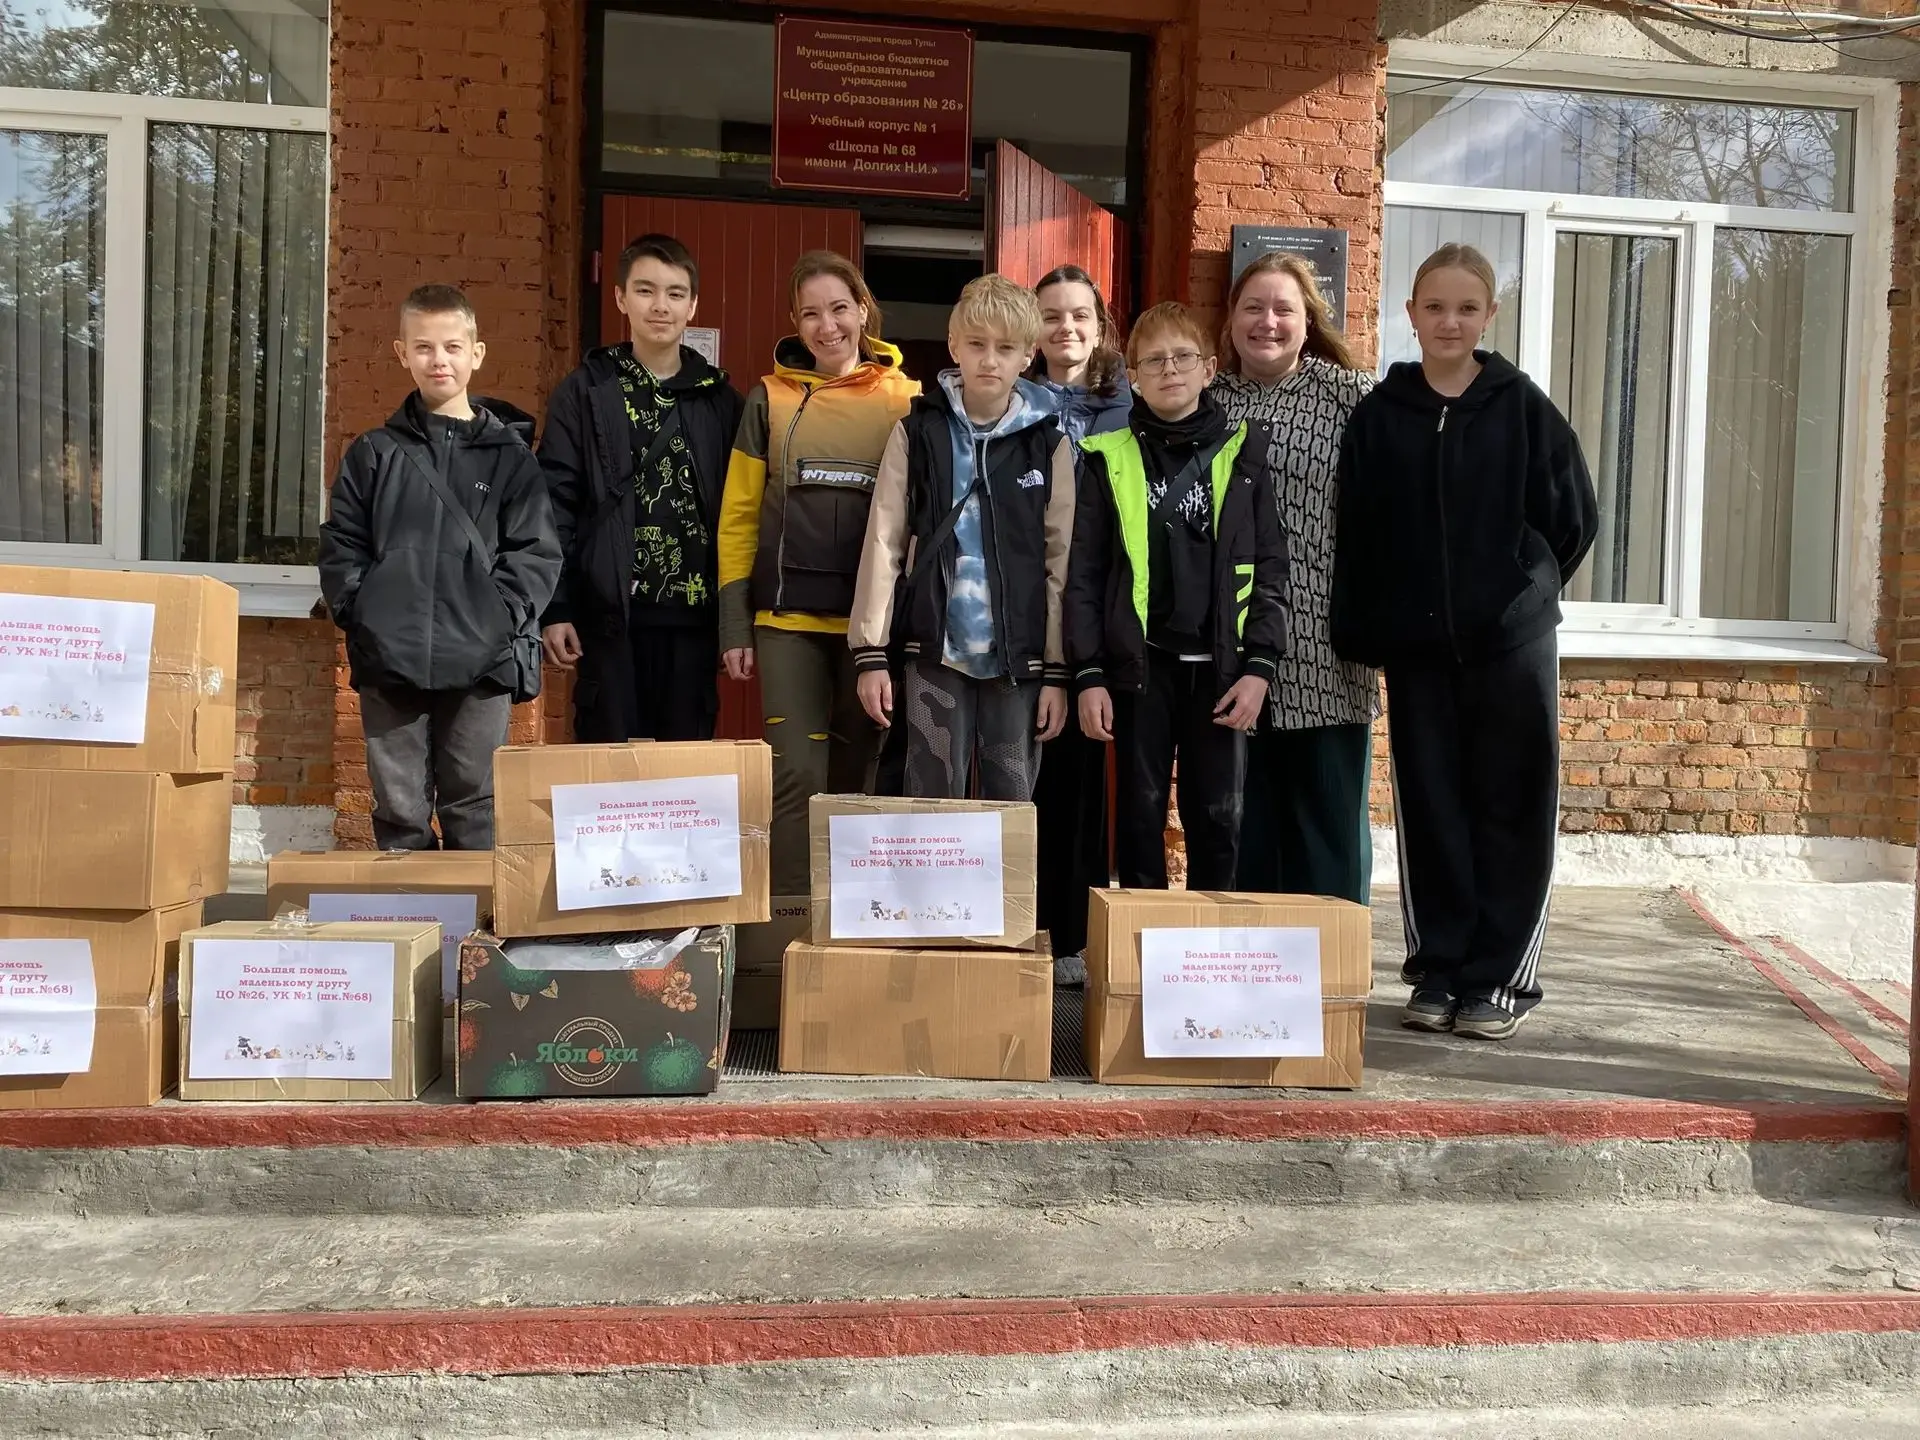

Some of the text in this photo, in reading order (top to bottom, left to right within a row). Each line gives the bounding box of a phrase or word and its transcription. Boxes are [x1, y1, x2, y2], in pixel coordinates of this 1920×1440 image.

[814, 29, 936, 48] Администрация города Тулы
[796, 45, 950, 67] Муниципальное бюджетное
[810, 61, 936, 78] общеобразовательное
[841, 75, 907, 88] учреждение
[782, 87, 964, 112] «Центр образования № 26»
[810, 113, 937, 134] Учебный корпус № 1
[828, 139, 917, 156] «Школа № 68
[804, 157, 938, 175] имени Долгих Н.И.»
[0, 621, 101, 634] льшая помощь
[0, 633, 104, 650] енькому другу
[16, 646, 35, 656] УК
[38, 648, 60, 658] №1
[64, 650, 127, 663] (шк.№68)
[599, 798, 697, 810] Большая помощь
[597, 808, 701, 822] маленькому другу
[576, 825, 594, 835] ЦО
[629, 822, 645, 831] УК
[648, 821, 666, 831] №1
[669, 818, 721, 831] (шк.№68)
[872, 836, 916, 844] Большая
[869, 848, 965, 857] маленькому другу
[851, 859, 866, 868] ЦО
[899, 859, 912, 867] УК
[915, 858, 932, 867] №1
[935, 857, 984, 868] (шк.№68)
[350, 914, 394, 922] Большая
[1184, 950, 1279, 959] Большая помощь
[243, 964, 348, 976] Большая помощь
[1182, 963, 1282, 972] маленькому другу
[9, 974, 48, 983] другу
[239, 978, 351, 991] маленькому другу
[1163, 974, 1179, 984] ЦО
[1213, 974, 1228, 983] УК
[1231, 974, 1247, 983] №1
[1251, 974, 1302, 984] (шк.№68)
[10, 984, 73, 997] (шк.№68)
[216, 990, 235, 1001] ЦО
[273, 991, 290, 1001] УК
[293, 991, 313, 1001] №1
[316, 992, 373, 1004] (шк.№68)
